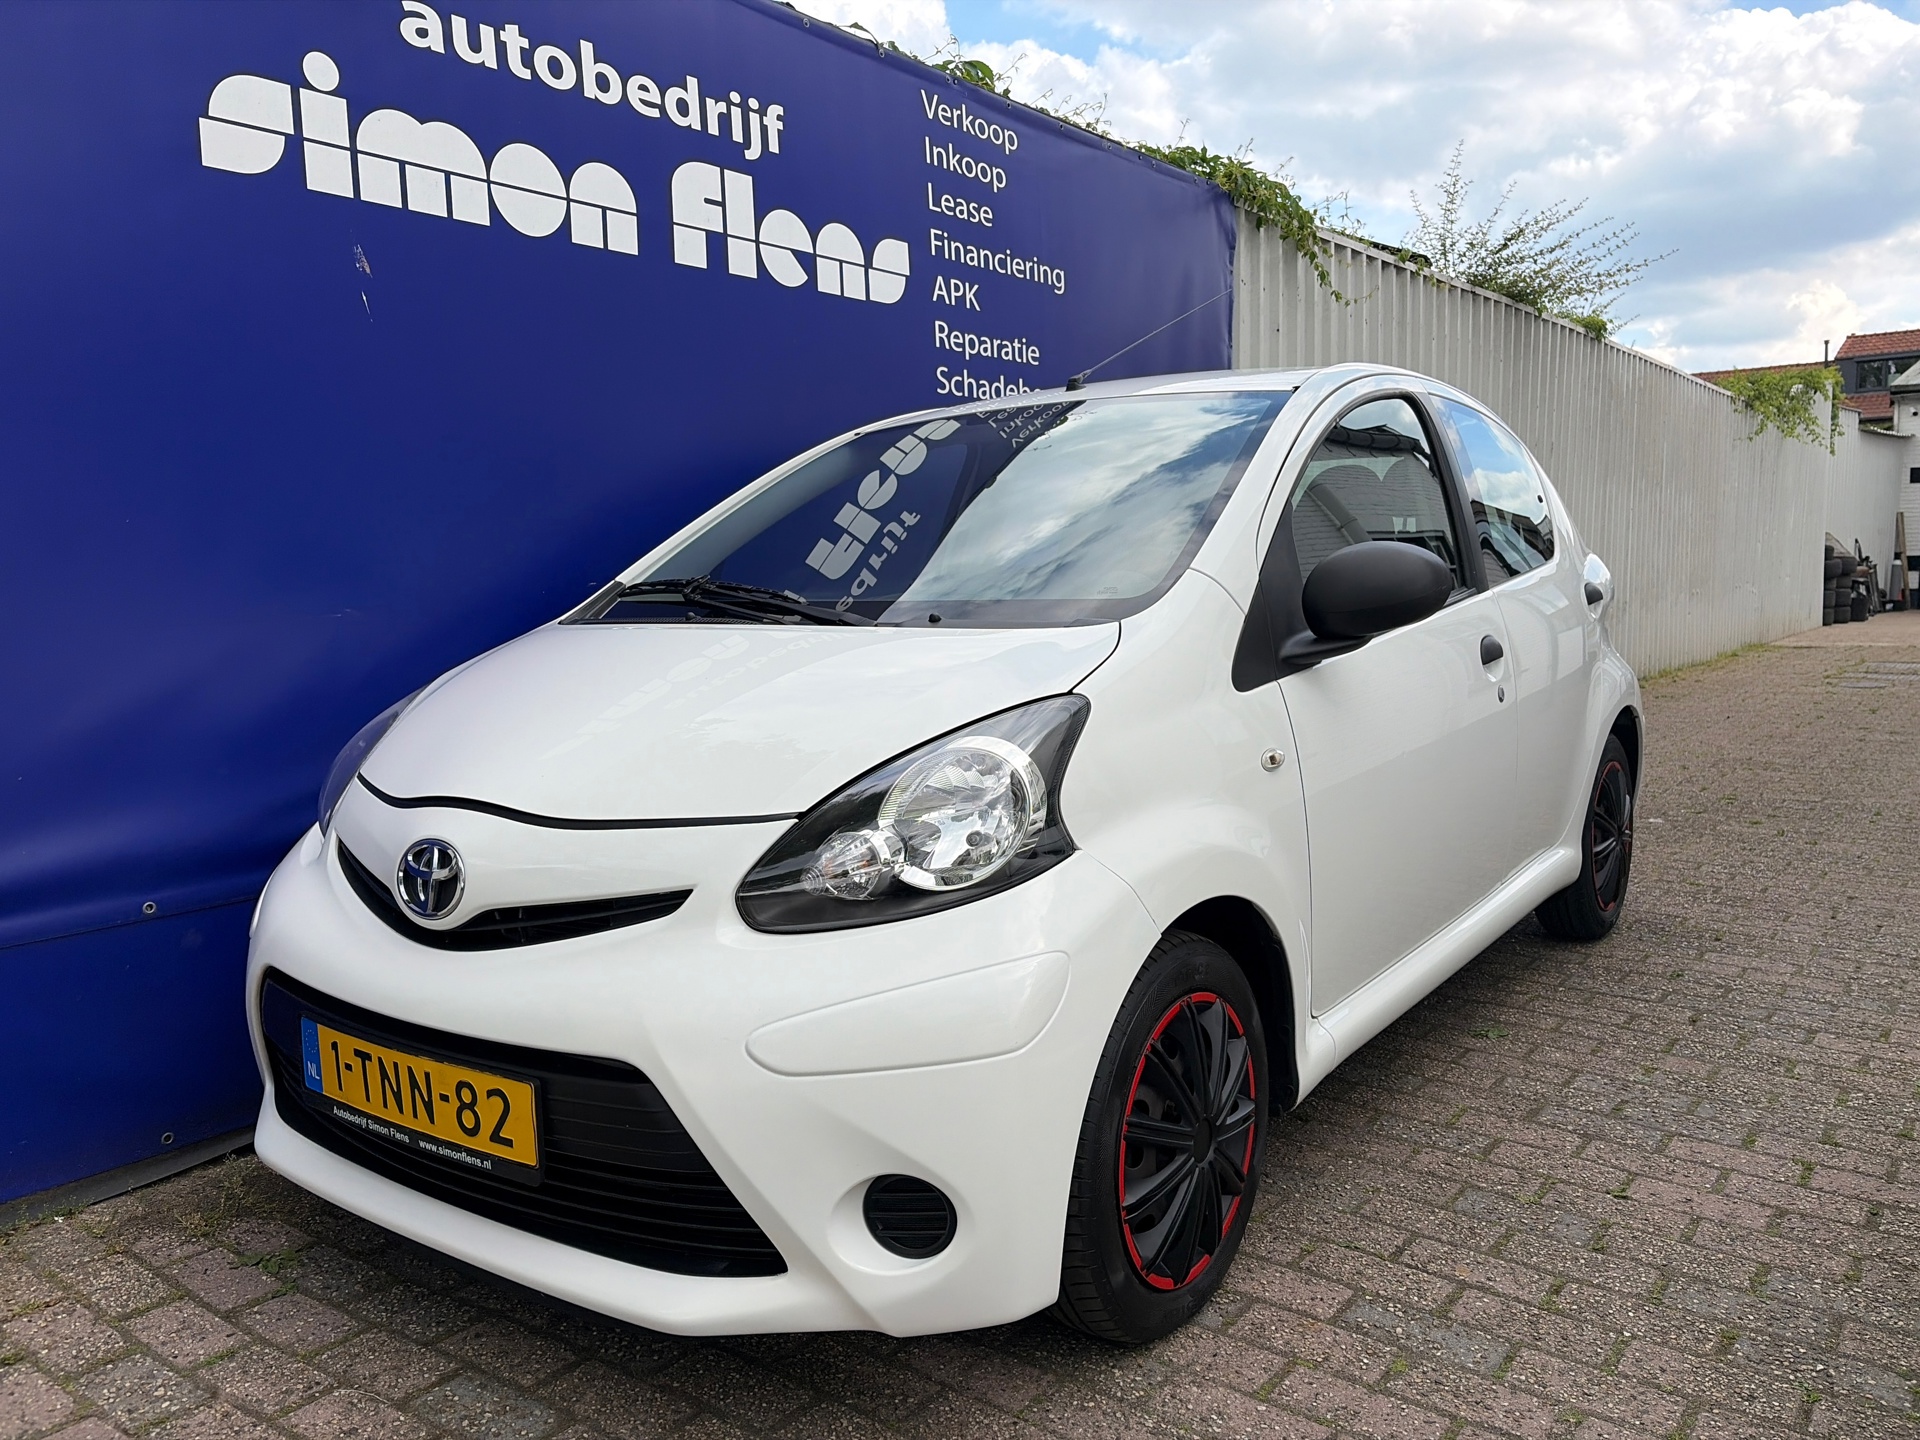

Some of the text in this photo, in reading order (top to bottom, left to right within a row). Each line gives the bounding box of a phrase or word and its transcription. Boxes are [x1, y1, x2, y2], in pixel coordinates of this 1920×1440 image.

[400, 0, 784, 160] autobedrijf
[920, 88, 1019, 156] Verkoop
[199, 51, 911, 304] simon flens
[924, 136, 1007, 194] Inkoop
[927, 182, 994, 227] Lease
[929, 228, 1065, 295] Financiering
[932, 276, 981, 312] APK
[934, 320, 1040, 366] Reparatie
[307, 1060, 321, 1080] NL
[331, 1041, 515, 1149] 1-TNN-82
[333, 1105, 492, 1170] Autobedrijf Simon Flens www.simonflens.nl
